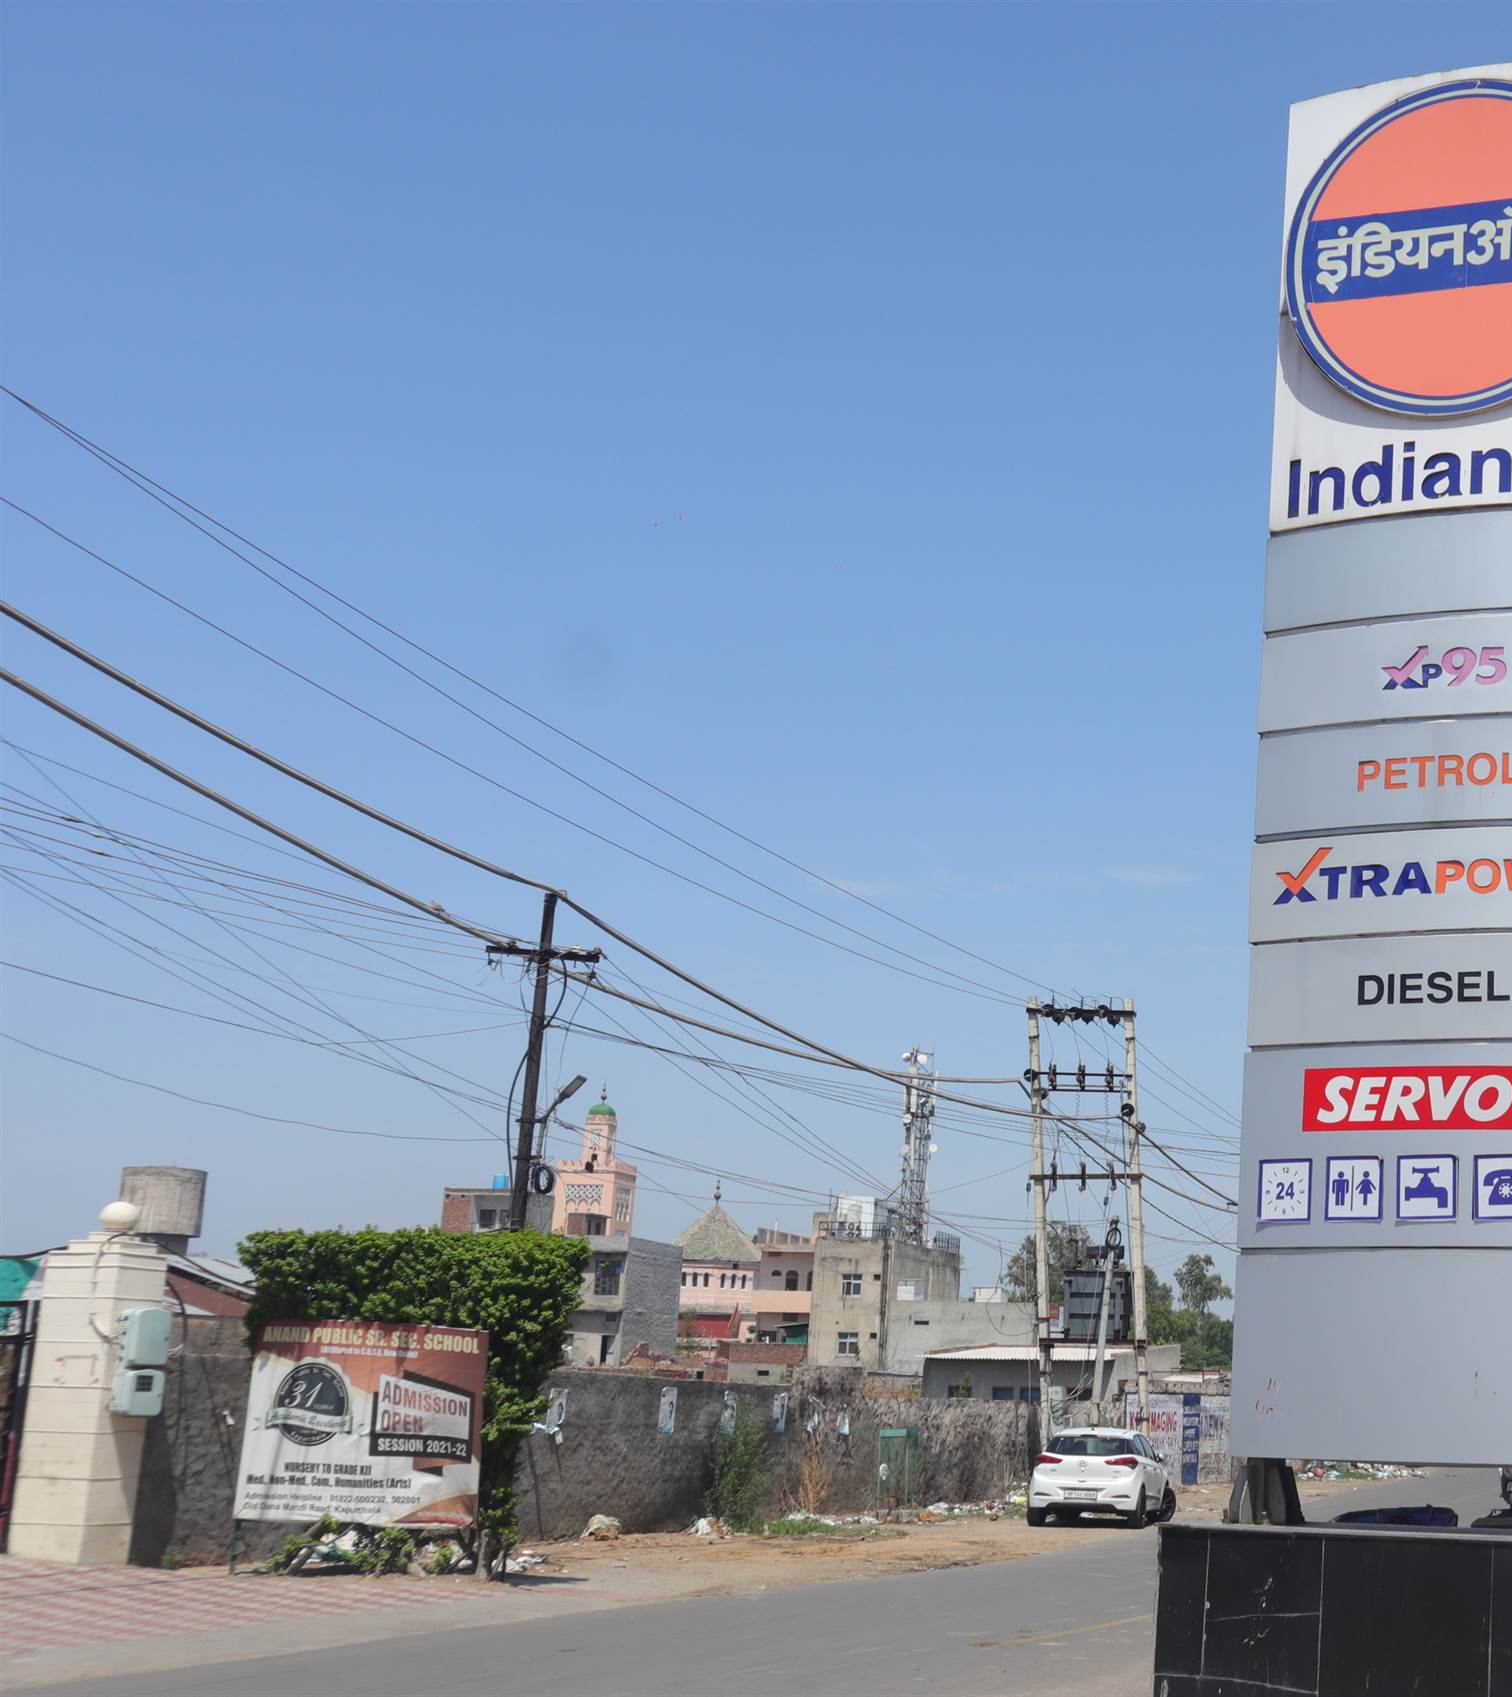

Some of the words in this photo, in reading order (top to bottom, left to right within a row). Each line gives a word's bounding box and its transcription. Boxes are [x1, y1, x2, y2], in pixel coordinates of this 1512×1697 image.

[1357, 970, 1510, 1006] DIESEL
[1275, 1181, 1296, 1201] 24
[263, 1326, 310, 1343] ANAND
[312, 1327, 363, 1345] PUBLIC
[391, 1331, 420, 1349] SEC.
[423, 1333, 480, 1354] SCHOOL
[284, 1380, 324, 1408] 31
[382, 1380, 468, 1417] ADMISSION
[380, 1408, 424, 1434] OPEN
[377, 1438, 424, 1452] SESSION
[426, 1440, 467, 1457] 2021-22
[333, 1464, 359, 1475] GRADE
